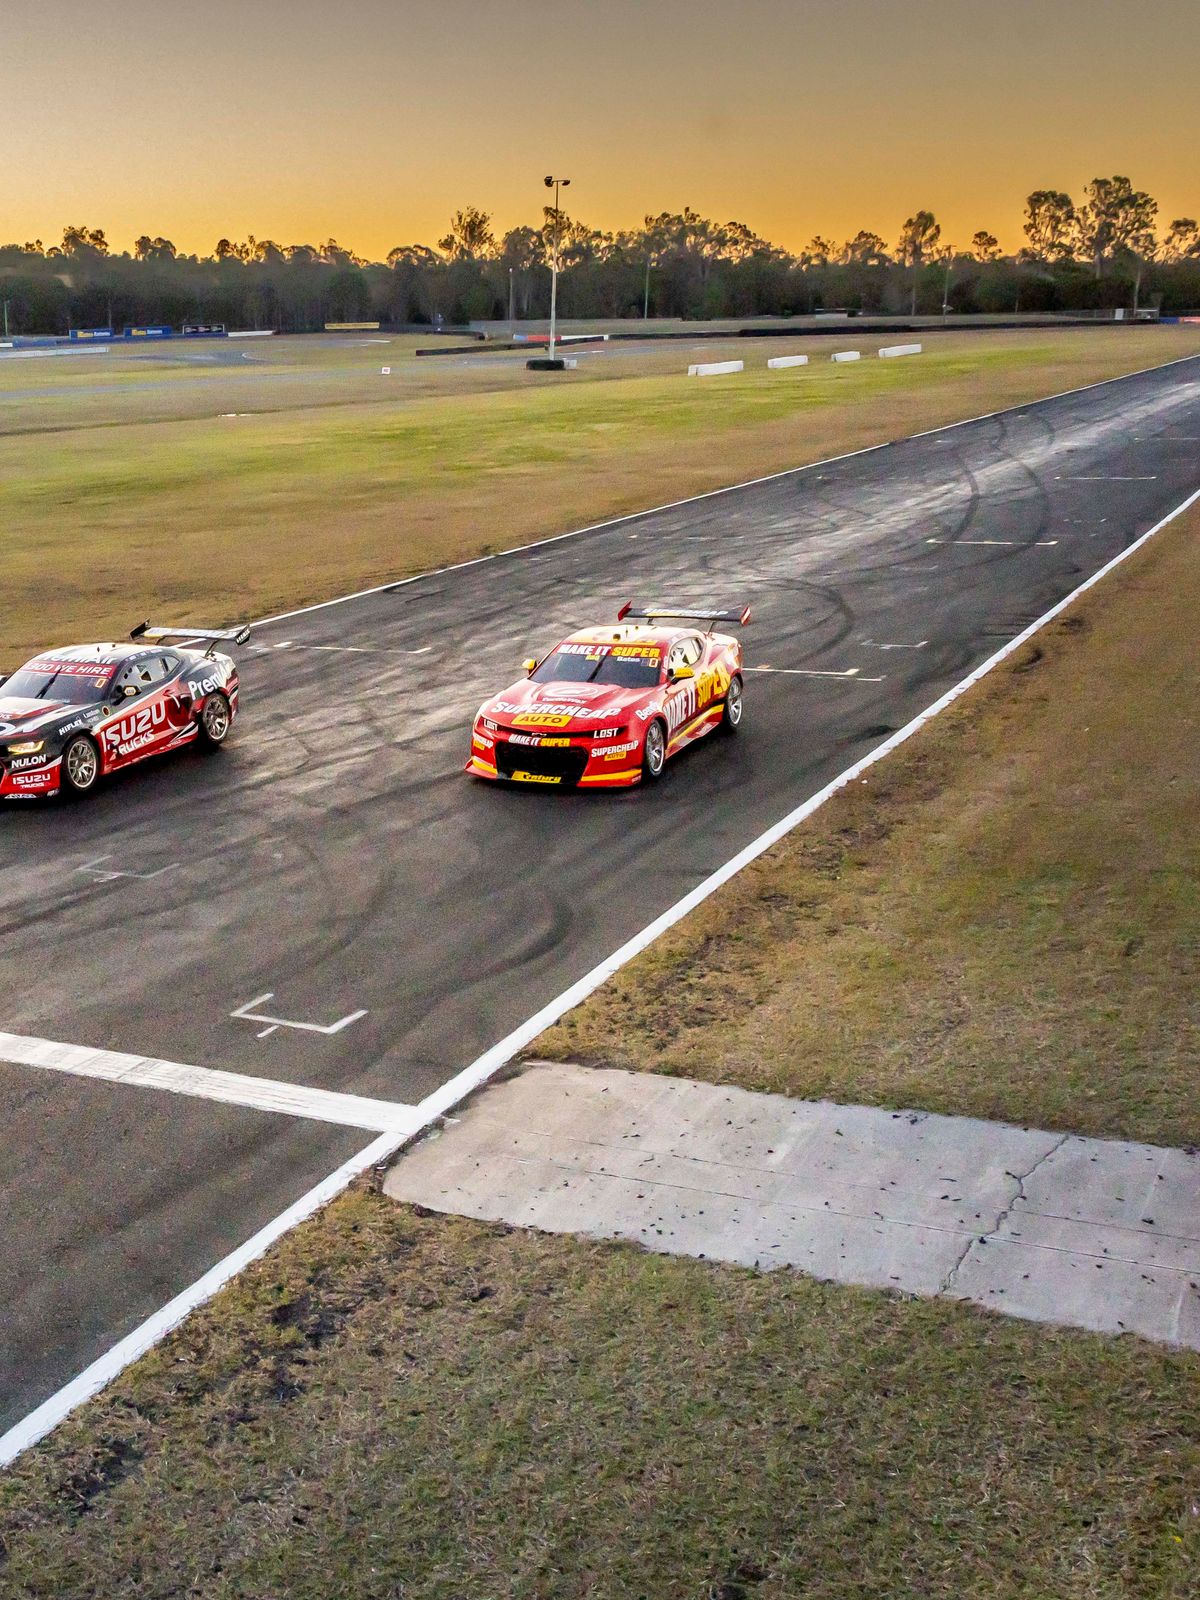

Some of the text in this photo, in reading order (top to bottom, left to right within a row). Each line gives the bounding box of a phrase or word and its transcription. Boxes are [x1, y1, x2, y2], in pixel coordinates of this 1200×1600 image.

[557, 644, 593, 655] MAKE
[594, 645, 611, 656] IT
[611, 646, 660, 658] SUPER
[54, 664, 76, 673] WE
[75, 666, 113, 675] HIRE
[490, 701, 622, 719] SUPERCHEAP
[101, 700, 166, 752] ISUZU
[519, 715, 563, 724] AUTO
[508, 733, 570, 747] MAKE IT SUPER
[593, 728, 619, 739] LOST
[591, 740, 639, 758] SUPERCHEAP
[606, 752, 625, 760] AUTO
[11, 754, 47, 769] NULON
[12, 773, 51, 785] ISUZU
